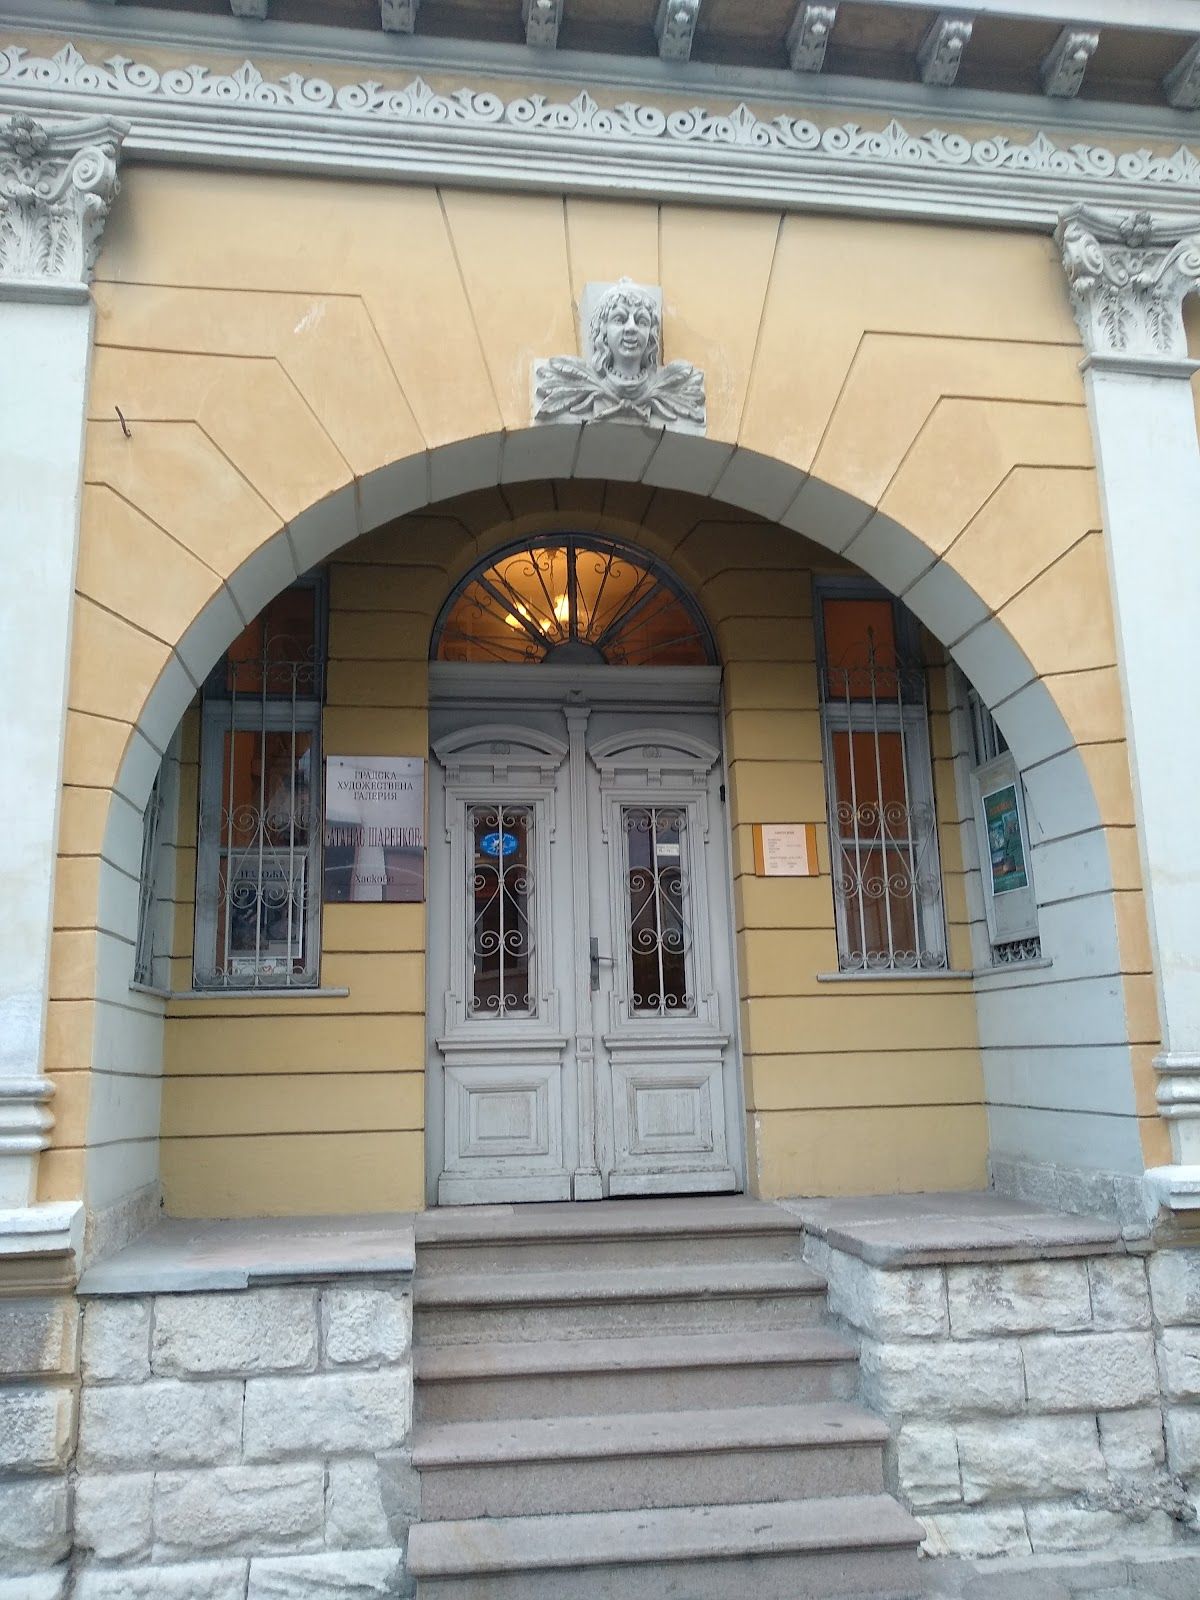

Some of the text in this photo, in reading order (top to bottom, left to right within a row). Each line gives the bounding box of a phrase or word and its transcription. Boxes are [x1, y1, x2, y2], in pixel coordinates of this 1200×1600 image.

[354, 771, 397, 780] ГРАДСКА
[337, 781, 413, 791] ХУДОЖЕСТВЕНА
[353, 791, 398, 801] ГАЛЕРИЯ
